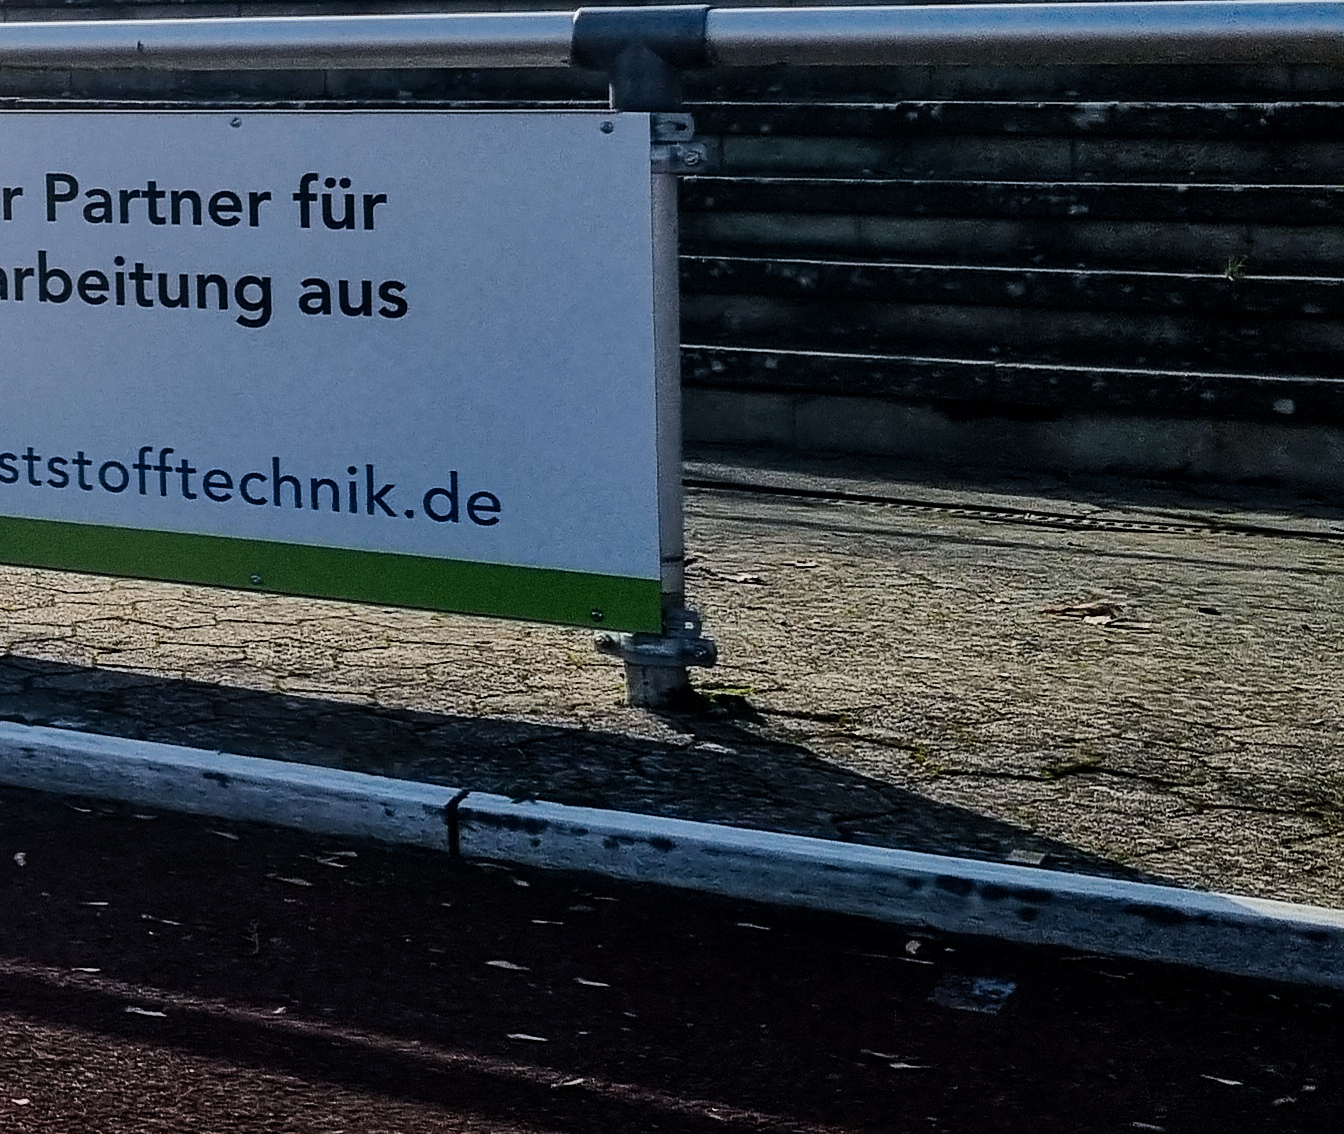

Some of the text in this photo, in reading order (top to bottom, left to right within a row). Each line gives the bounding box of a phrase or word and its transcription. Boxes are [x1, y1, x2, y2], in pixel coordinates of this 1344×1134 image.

[45, 172, 272, 228] Partner
[292, 172, 388, 231] für
[298, 277, 409, 319] aus
